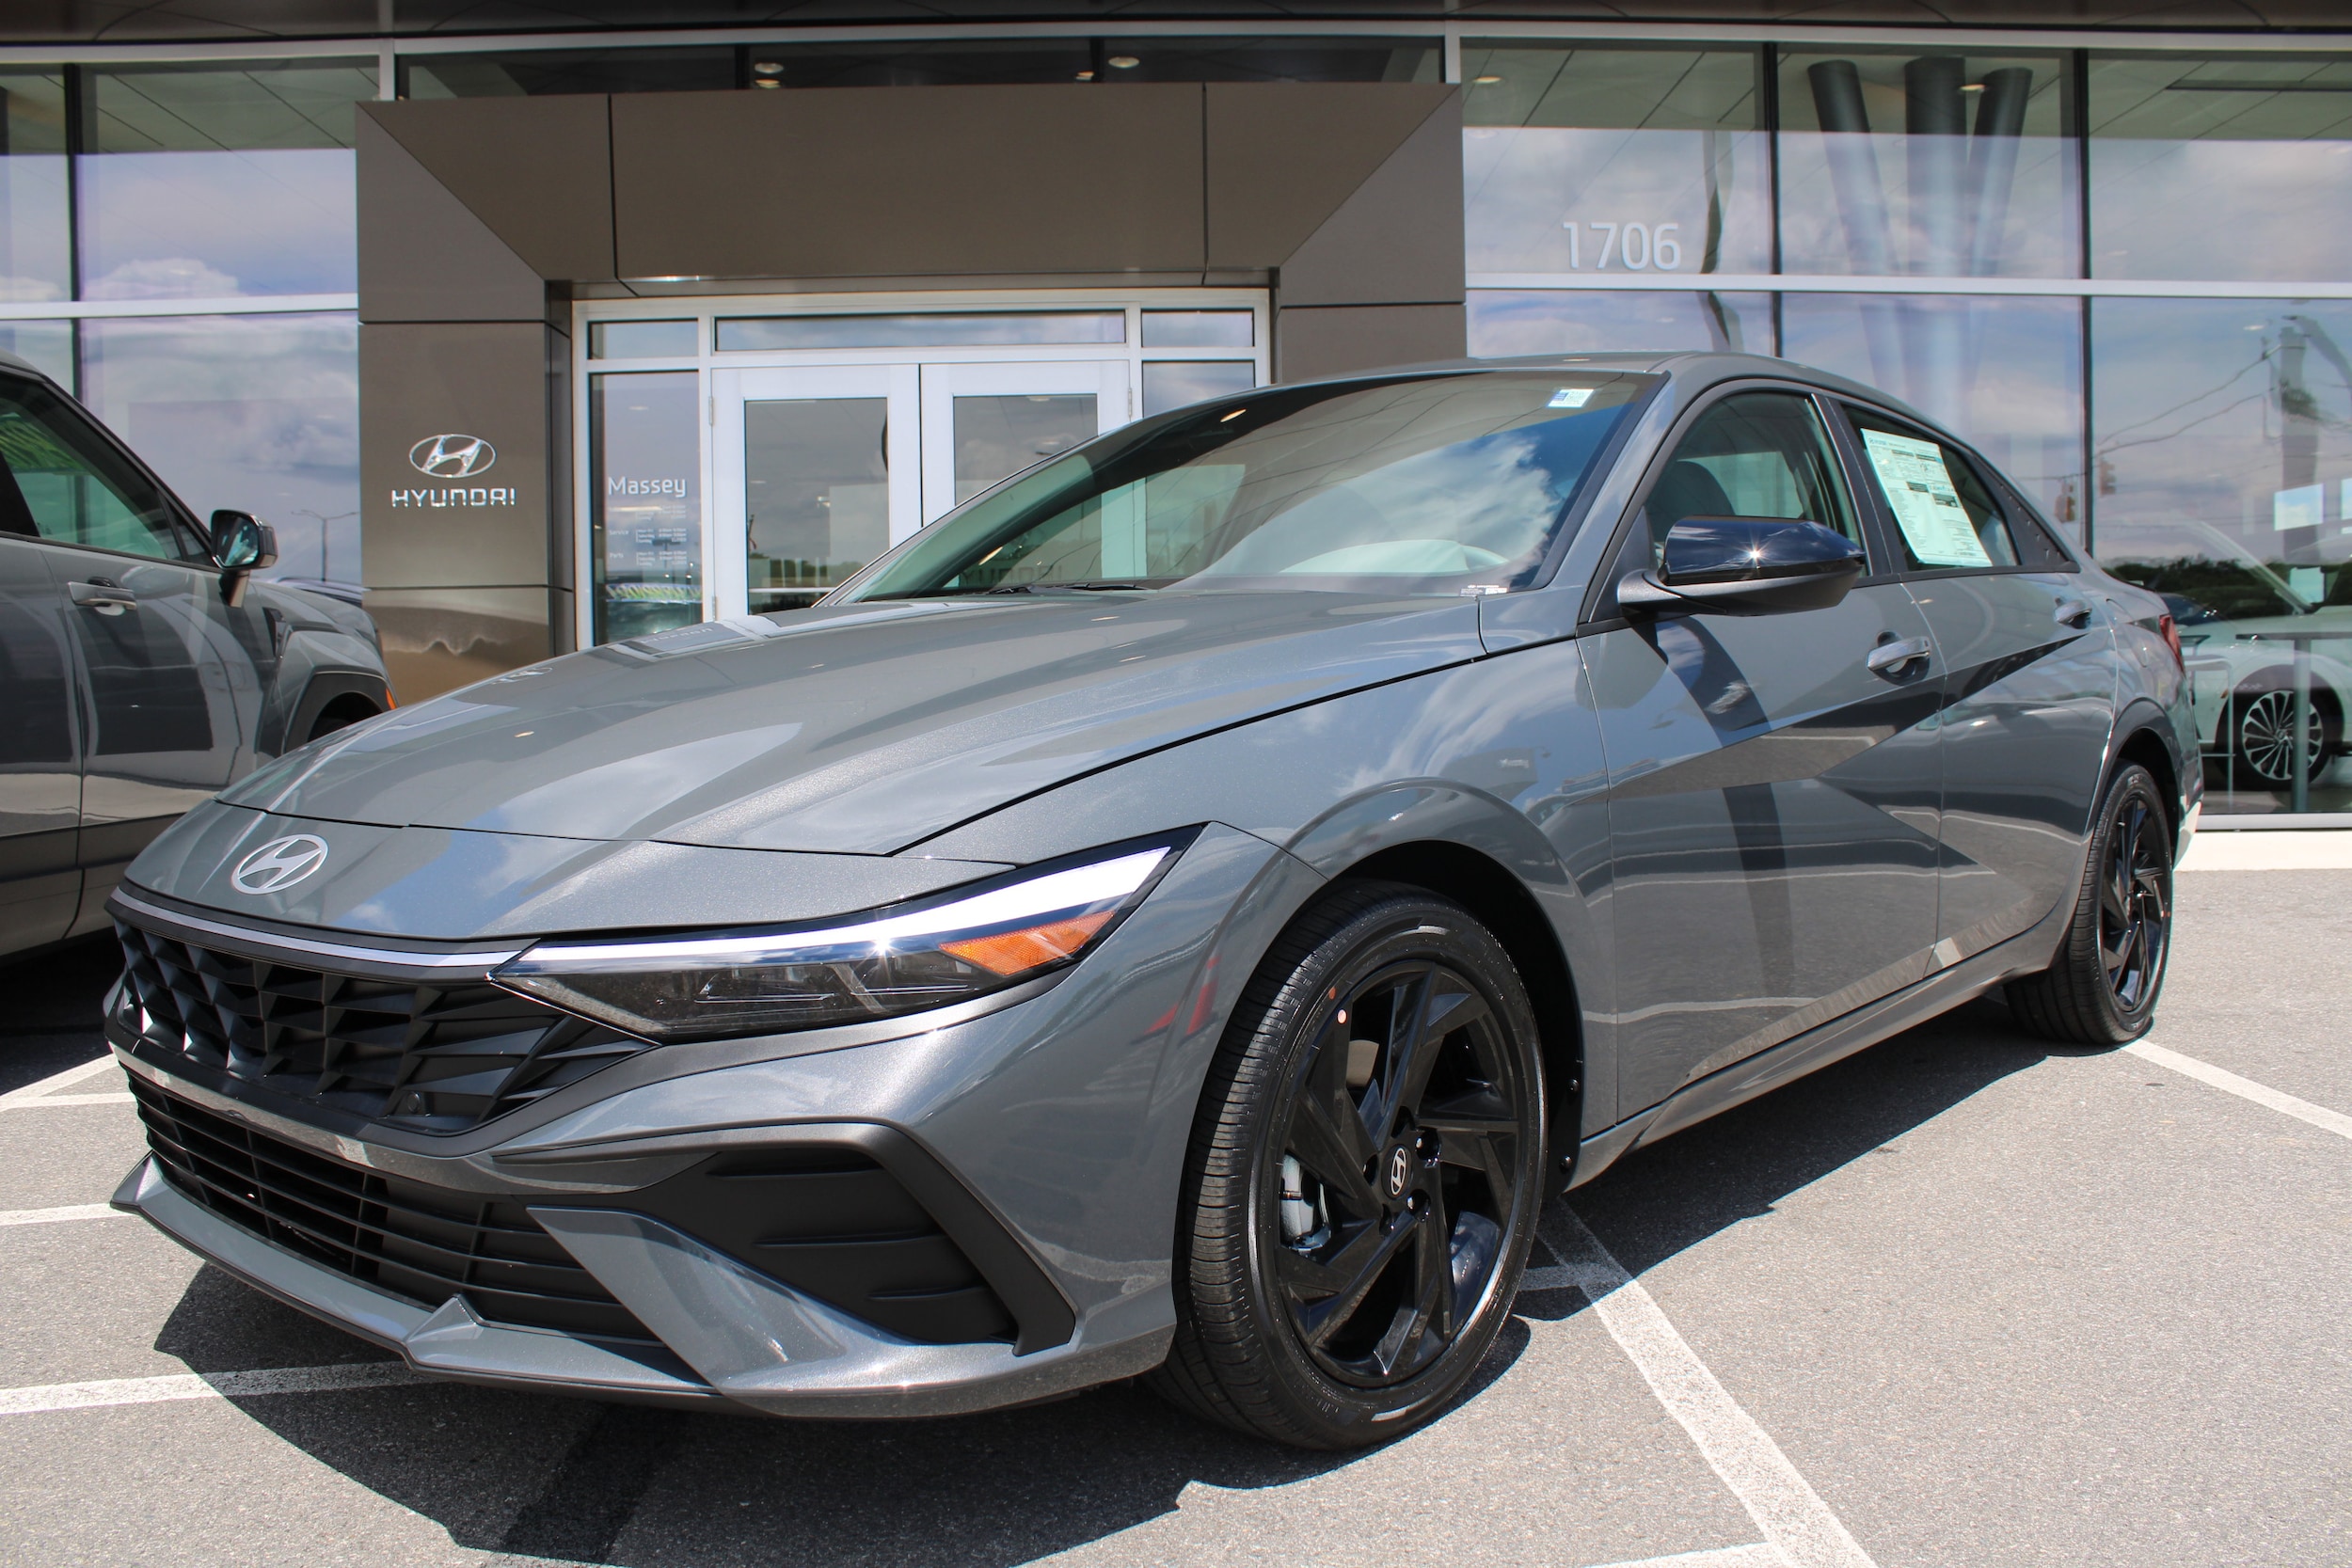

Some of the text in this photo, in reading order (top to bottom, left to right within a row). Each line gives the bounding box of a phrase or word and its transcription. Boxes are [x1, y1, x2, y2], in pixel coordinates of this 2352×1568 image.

[1563, 221, 1681, 270] 1706
[390, 487, 516, 508] HYUNDAI
[608, 476, 687, 498] Massey
